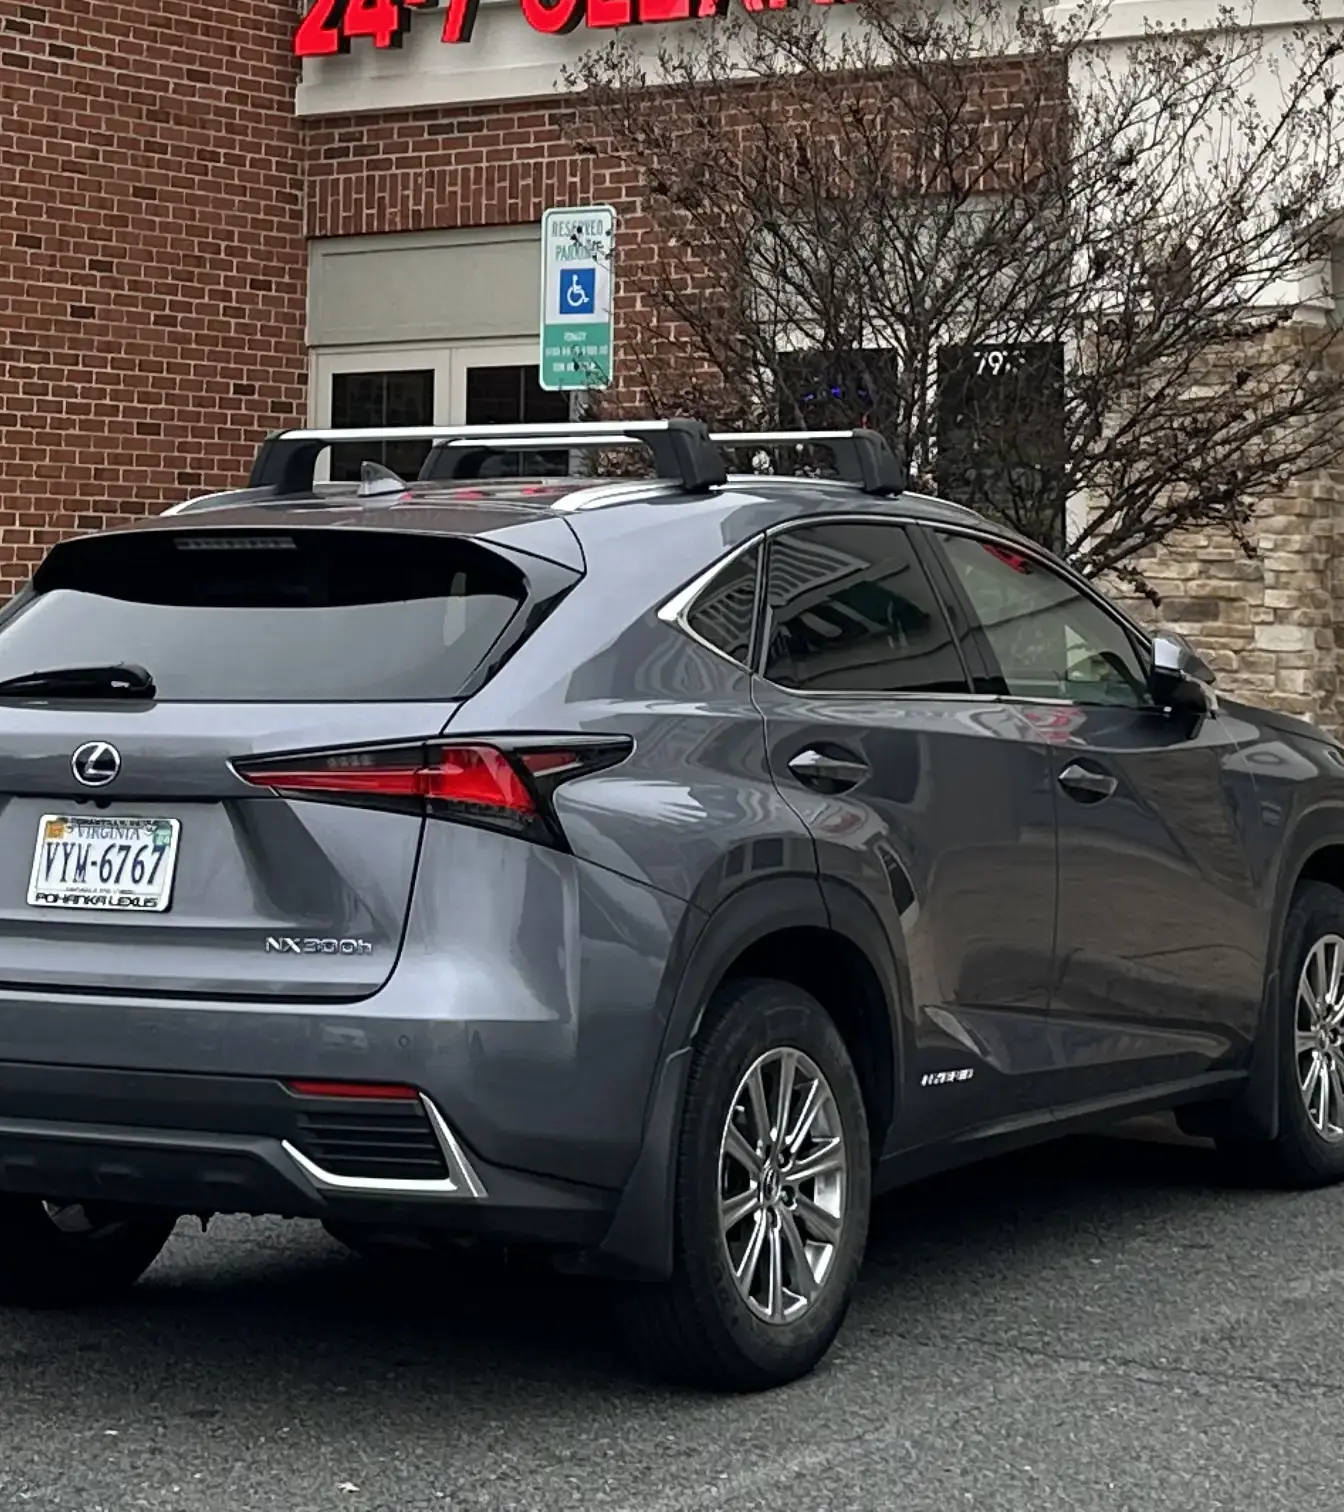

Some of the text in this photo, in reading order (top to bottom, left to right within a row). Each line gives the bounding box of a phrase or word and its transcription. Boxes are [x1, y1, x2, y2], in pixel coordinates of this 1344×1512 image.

[77, 825, 141, 841] VIRGINIA
[45, 841, 168, 886] VYM-6767
[36, 893, 159, 908] POHANKA LEXUS
